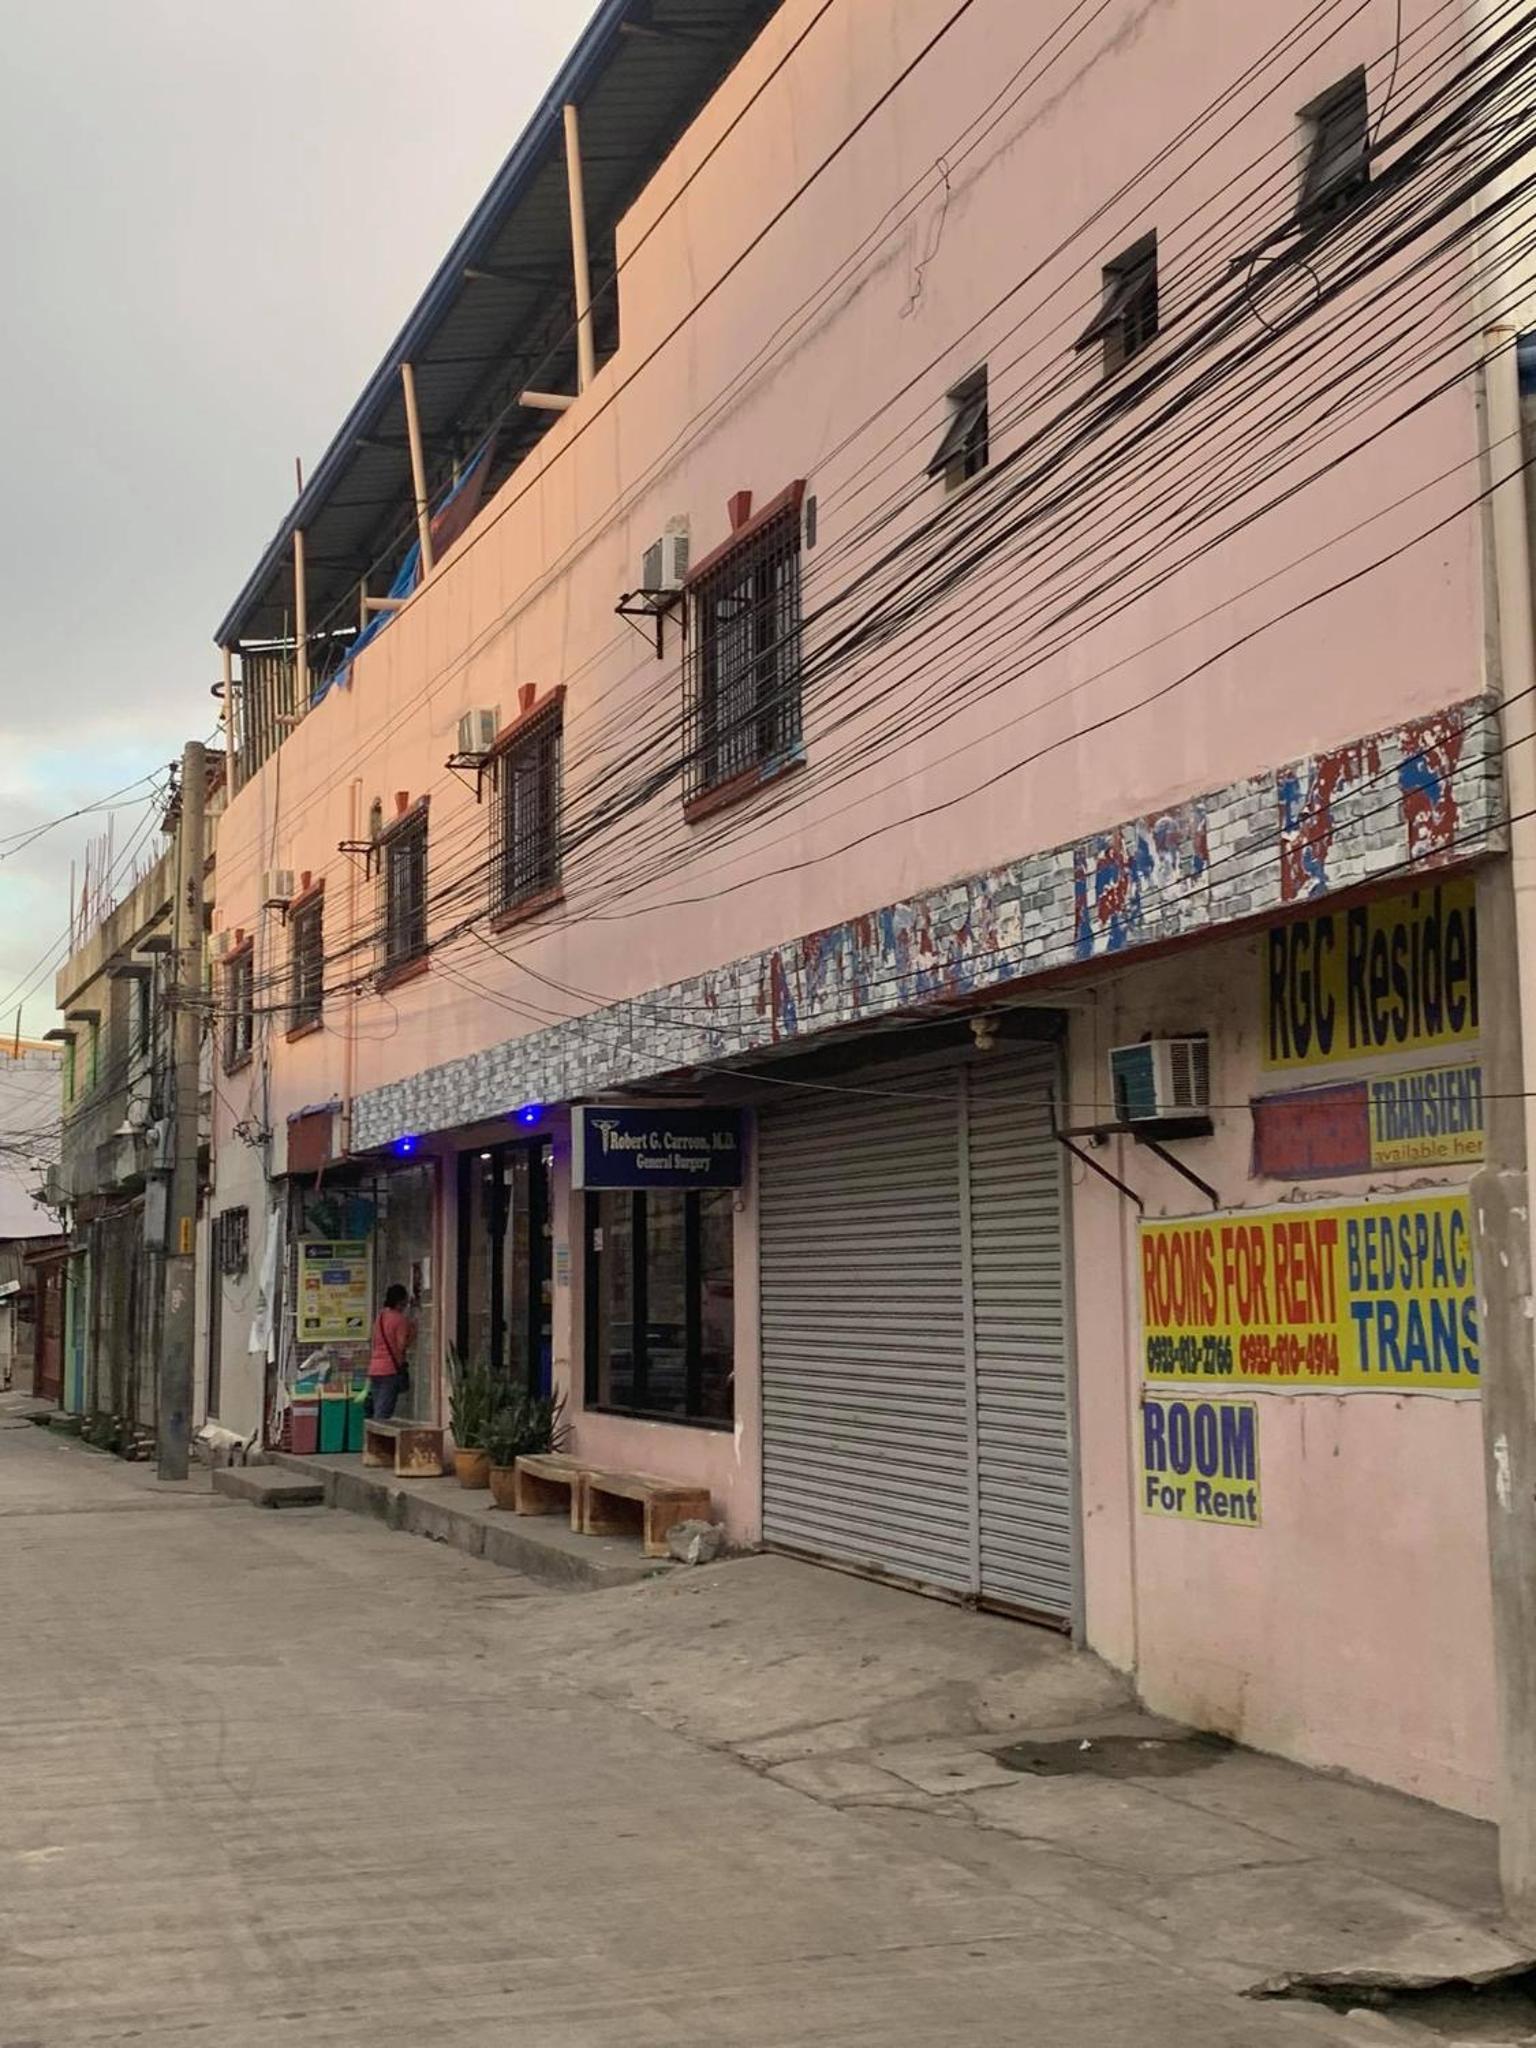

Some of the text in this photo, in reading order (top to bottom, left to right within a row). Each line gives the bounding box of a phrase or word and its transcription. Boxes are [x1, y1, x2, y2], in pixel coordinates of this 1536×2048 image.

[1268, 914, 1335, 1061] RGC
[610, 1131, 647, 1150] Robert
[650, 1131, 662, 1150] G.
[1371, 1067, 1483, 1142] TRANSIENT
[636, 1153, 711, 1172] General Surgery
[1375, 1142, 1448, 1162] available
[1142, 1218, 1338, 1328] ROOMS FOR RENT
[1346, 1209, 1476, 1293] BEDSPAC
[1351, 1297, 1480, 1374] TRANS
[1143, 1402, 1256, 1481] ROOM
[1146, 1477, 1257, 1521] For Rent
